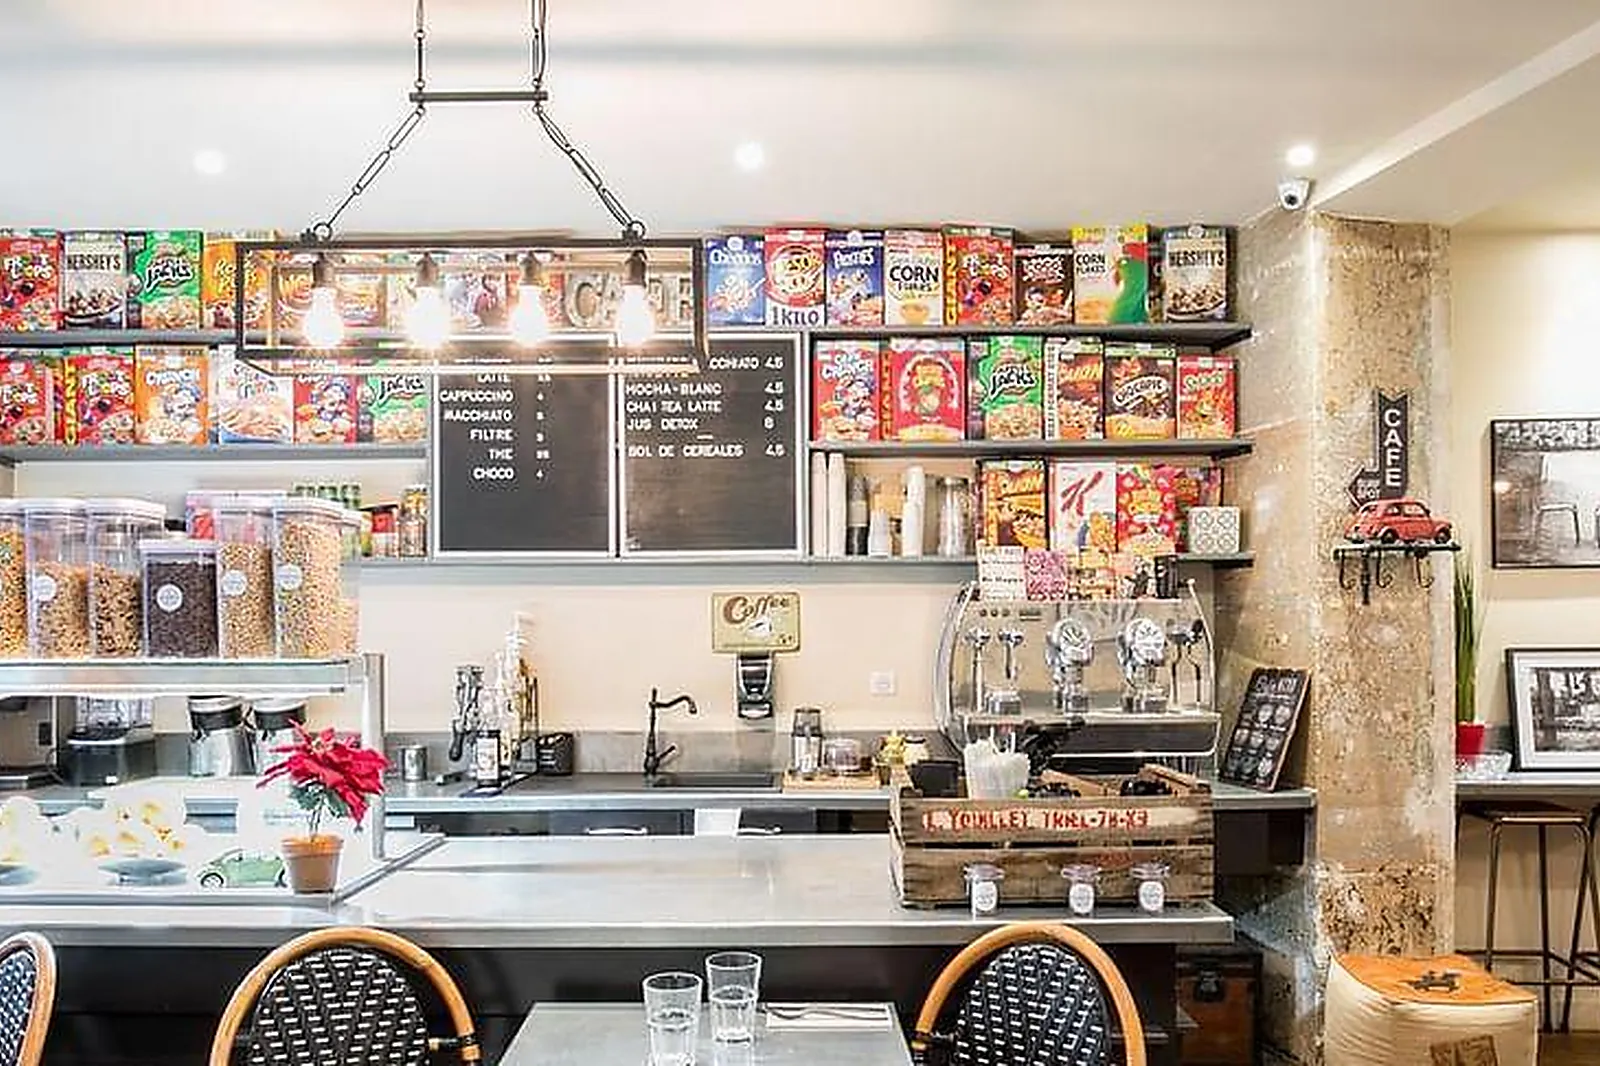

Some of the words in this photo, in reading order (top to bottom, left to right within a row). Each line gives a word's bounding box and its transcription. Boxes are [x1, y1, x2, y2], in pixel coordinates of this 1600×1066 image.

[1076, 253, 1106, 266] CORN
[889, 264, 939, 283] CORN
[439, 389, 514, 402] CAPPUCCINO
[625, 400, 657, 413] CHAI
[661, 401, 682, 413] TEA
[688, 400, 722, 412] LATTE
[444, 409, 513, 422] MACCHIATO
[626, 418, 652, 431] JUS
[661, 418, 700, 431] DETOX
[470, 429, 514, 441] FILTRE
[489, 448, 514, 460] THE
[628, 444, 653, 457] BOL
[658, 445, 675, 457] DE
[1384, 408, 1403, 487] CAFE
[472, 466, 515, 480] CHOCO
[723, 596, 790, 624] Coffee
